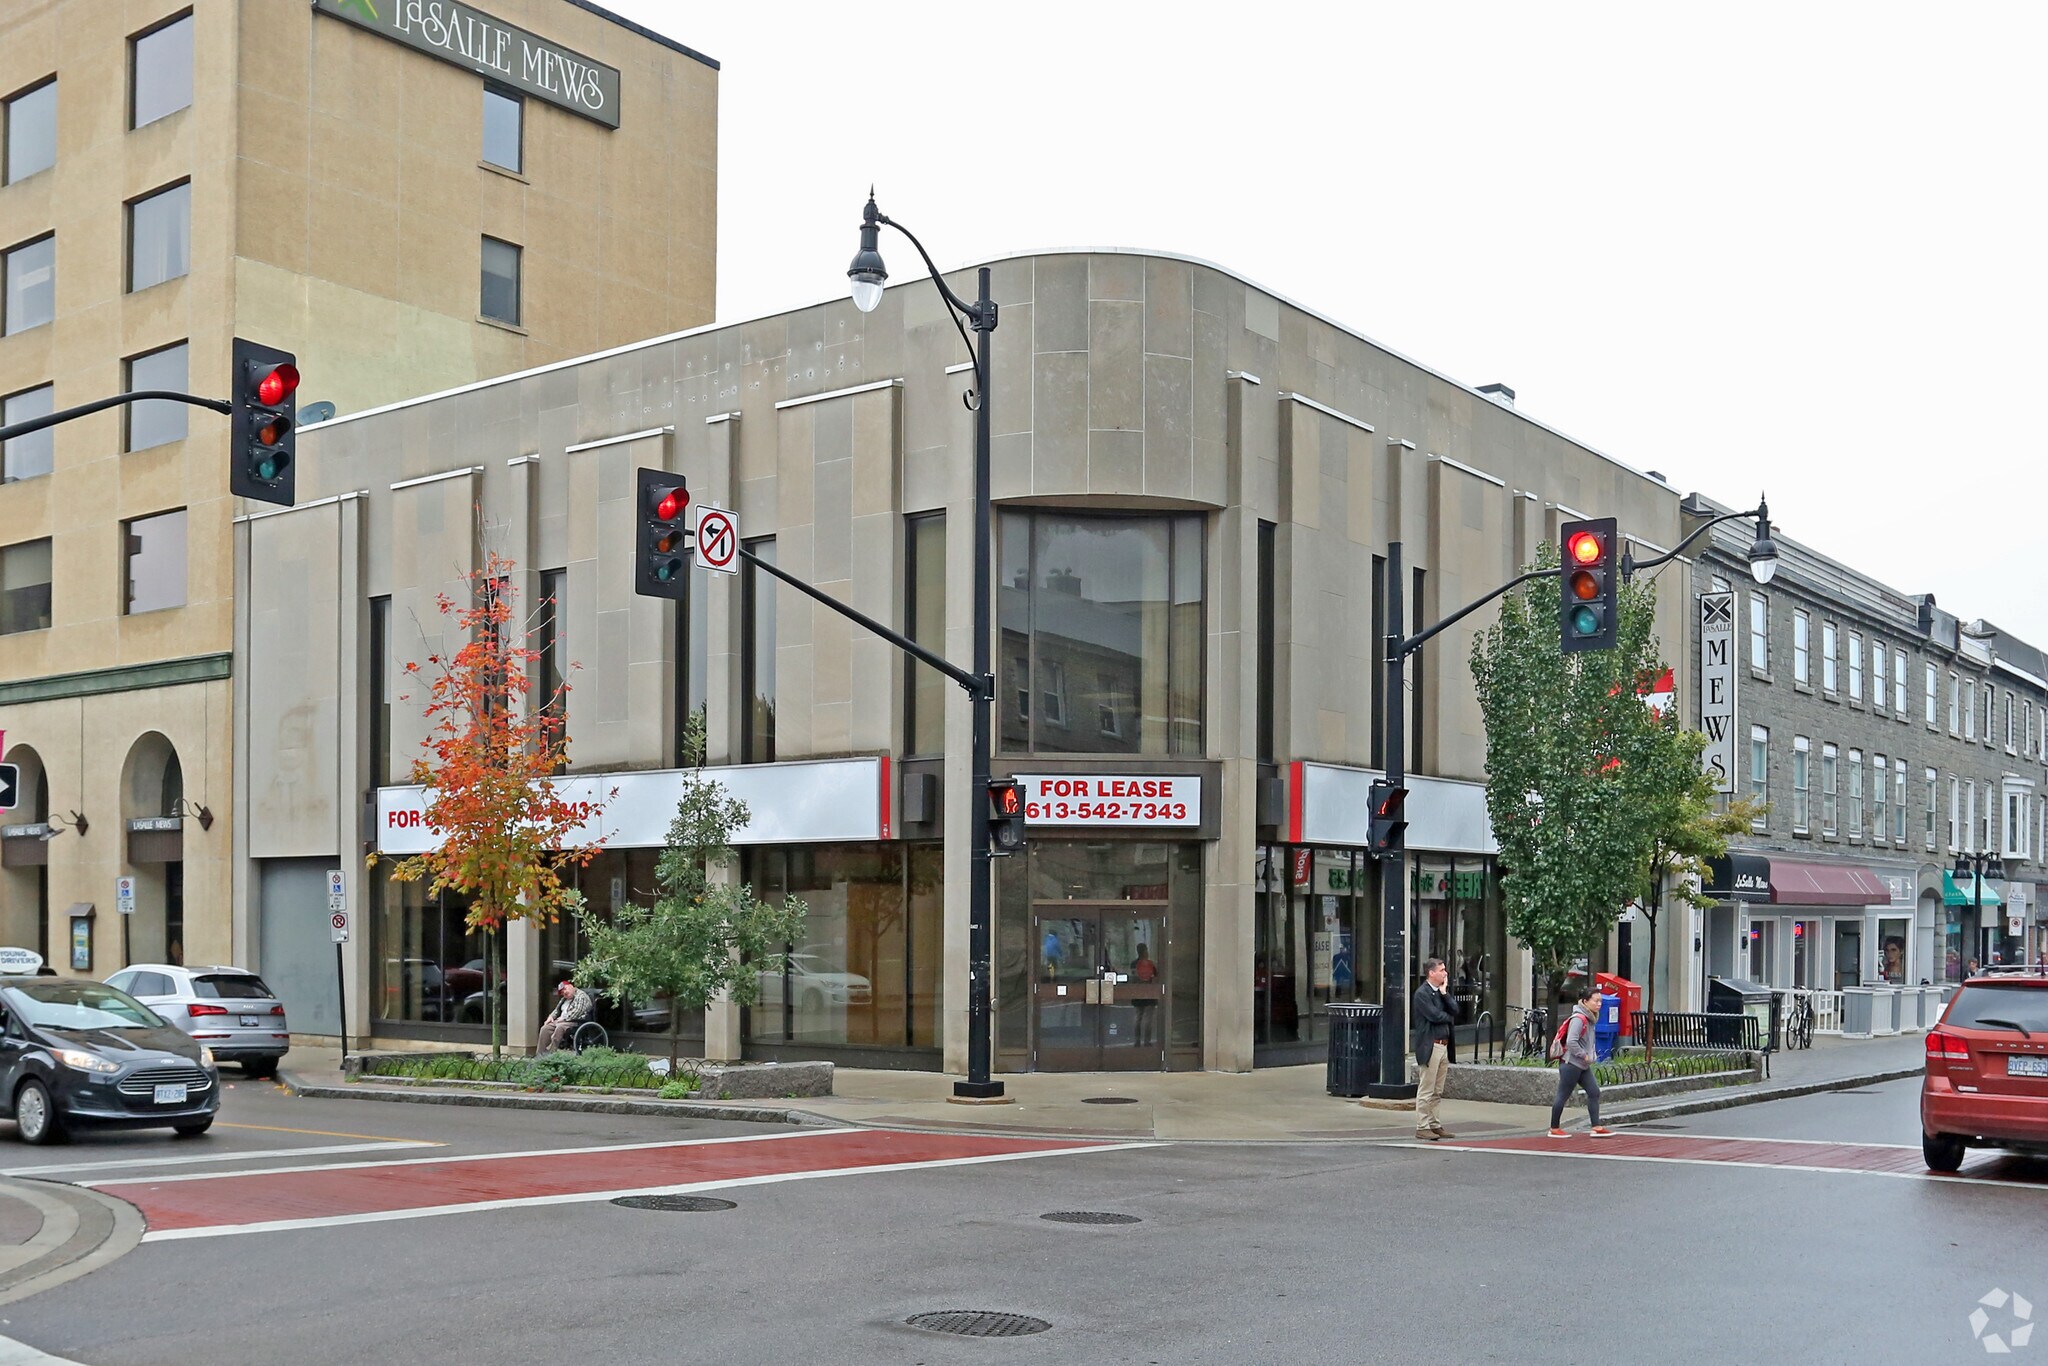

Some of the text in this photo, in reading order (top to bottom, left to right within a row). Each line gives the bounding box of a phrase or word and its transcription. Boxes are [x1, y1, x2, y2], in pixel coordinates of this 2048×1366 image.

[521, 40, 604, 110] MEWS
[1040, 780, 1173, 797] FOR LEASE
[388, 810, 420, 828] FOR
[1026, 802, 1187, 819] 613-542-7343
